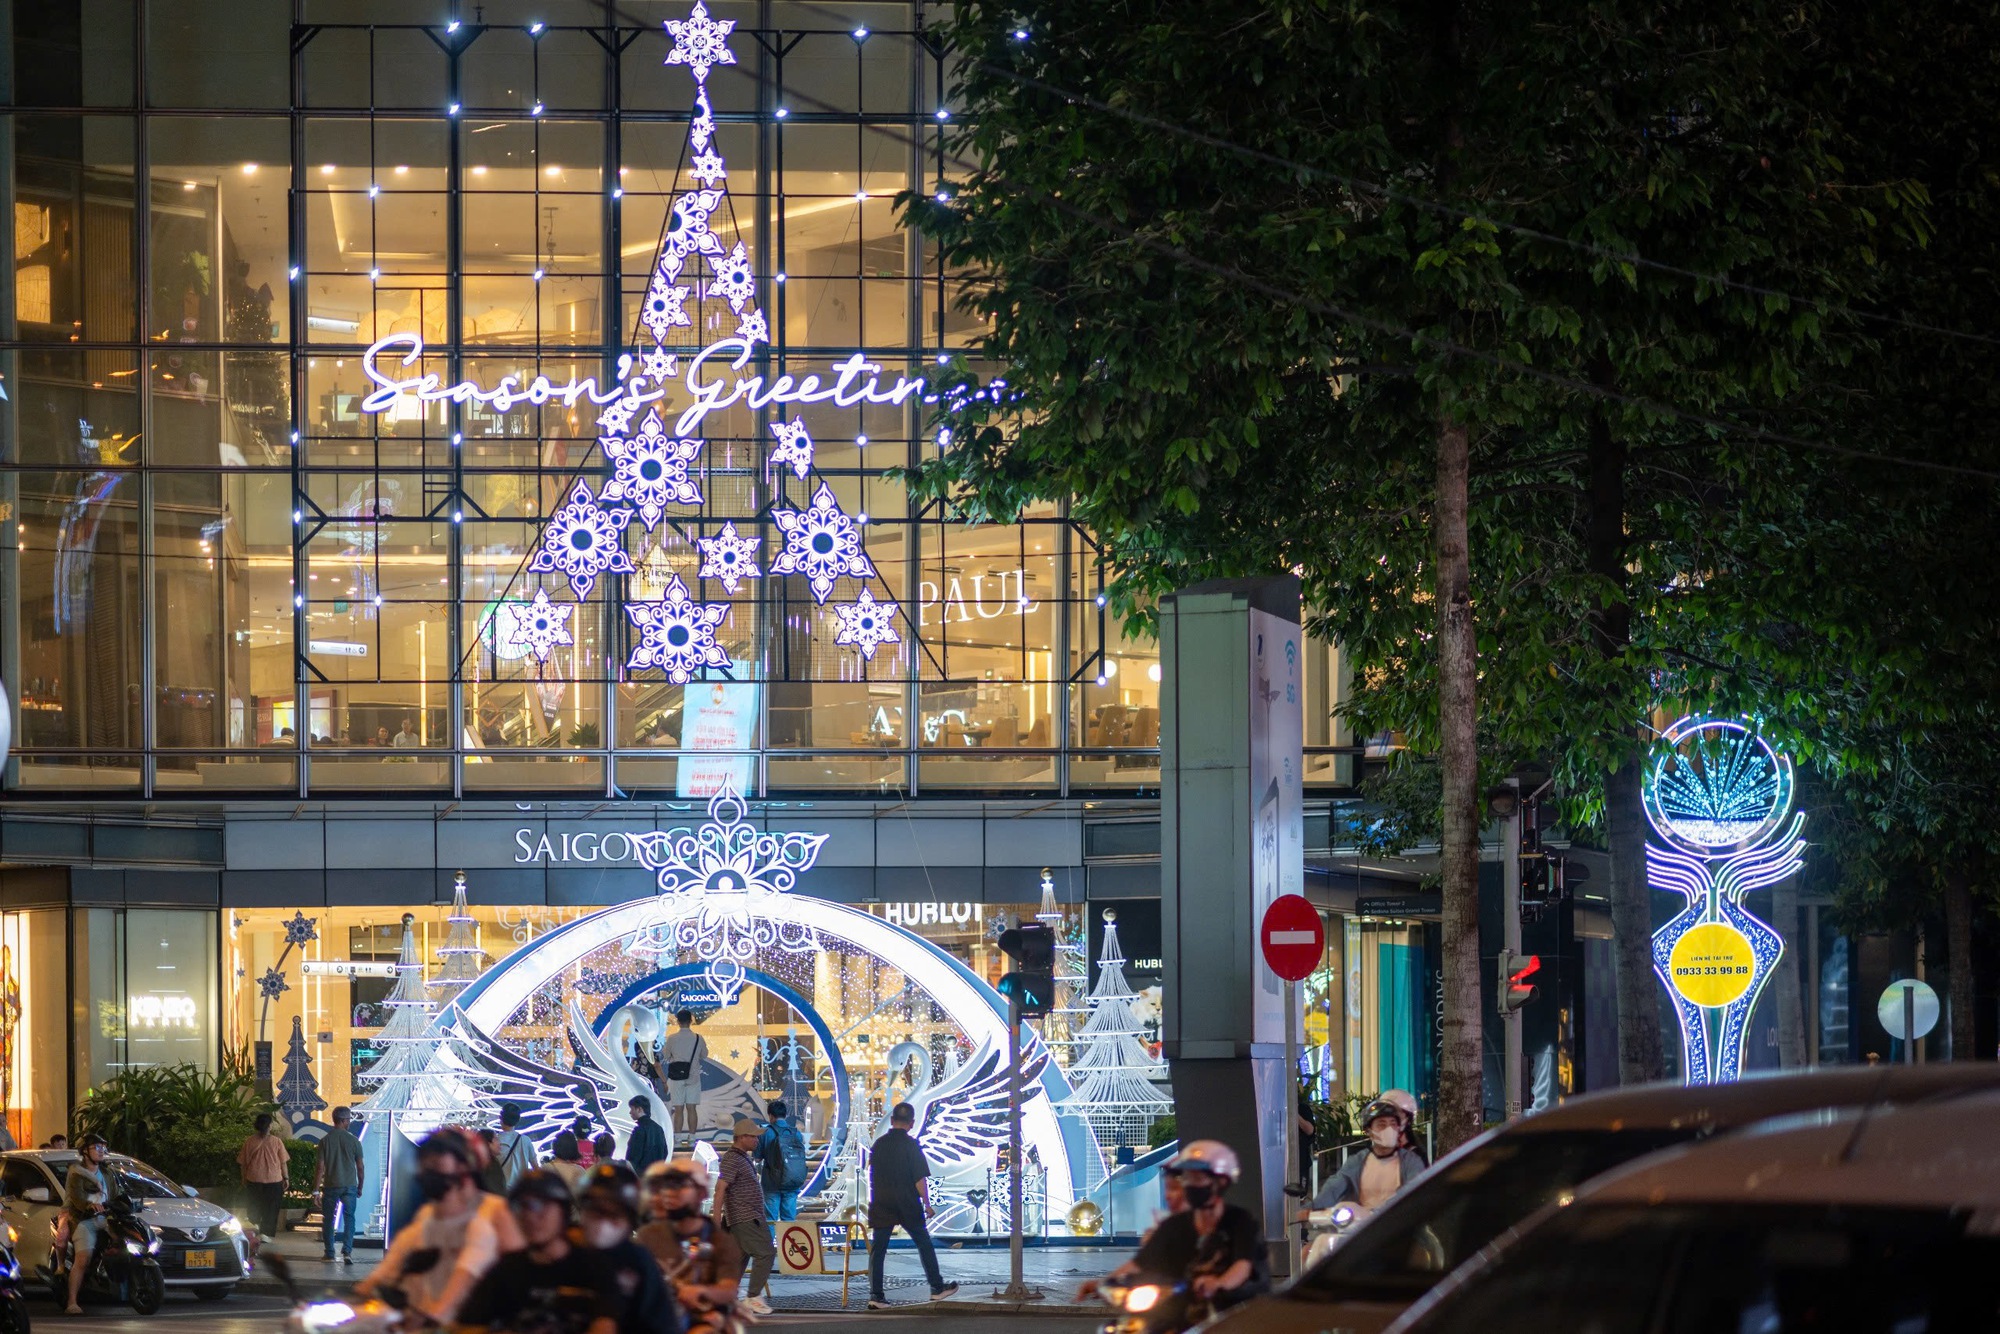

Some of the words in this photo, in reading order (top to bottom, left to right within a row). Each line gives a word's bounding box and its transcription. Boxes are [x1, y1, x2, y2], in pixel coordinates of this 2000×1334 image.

[362, 333, 665, 413] Season's
[674, 337, 1025, 437] Greetin
[920, 569, 1040, 626] PAUL
[1134, 958, 1163, 969] HUBL
[1472, 1113, 1479, 1126] 2
